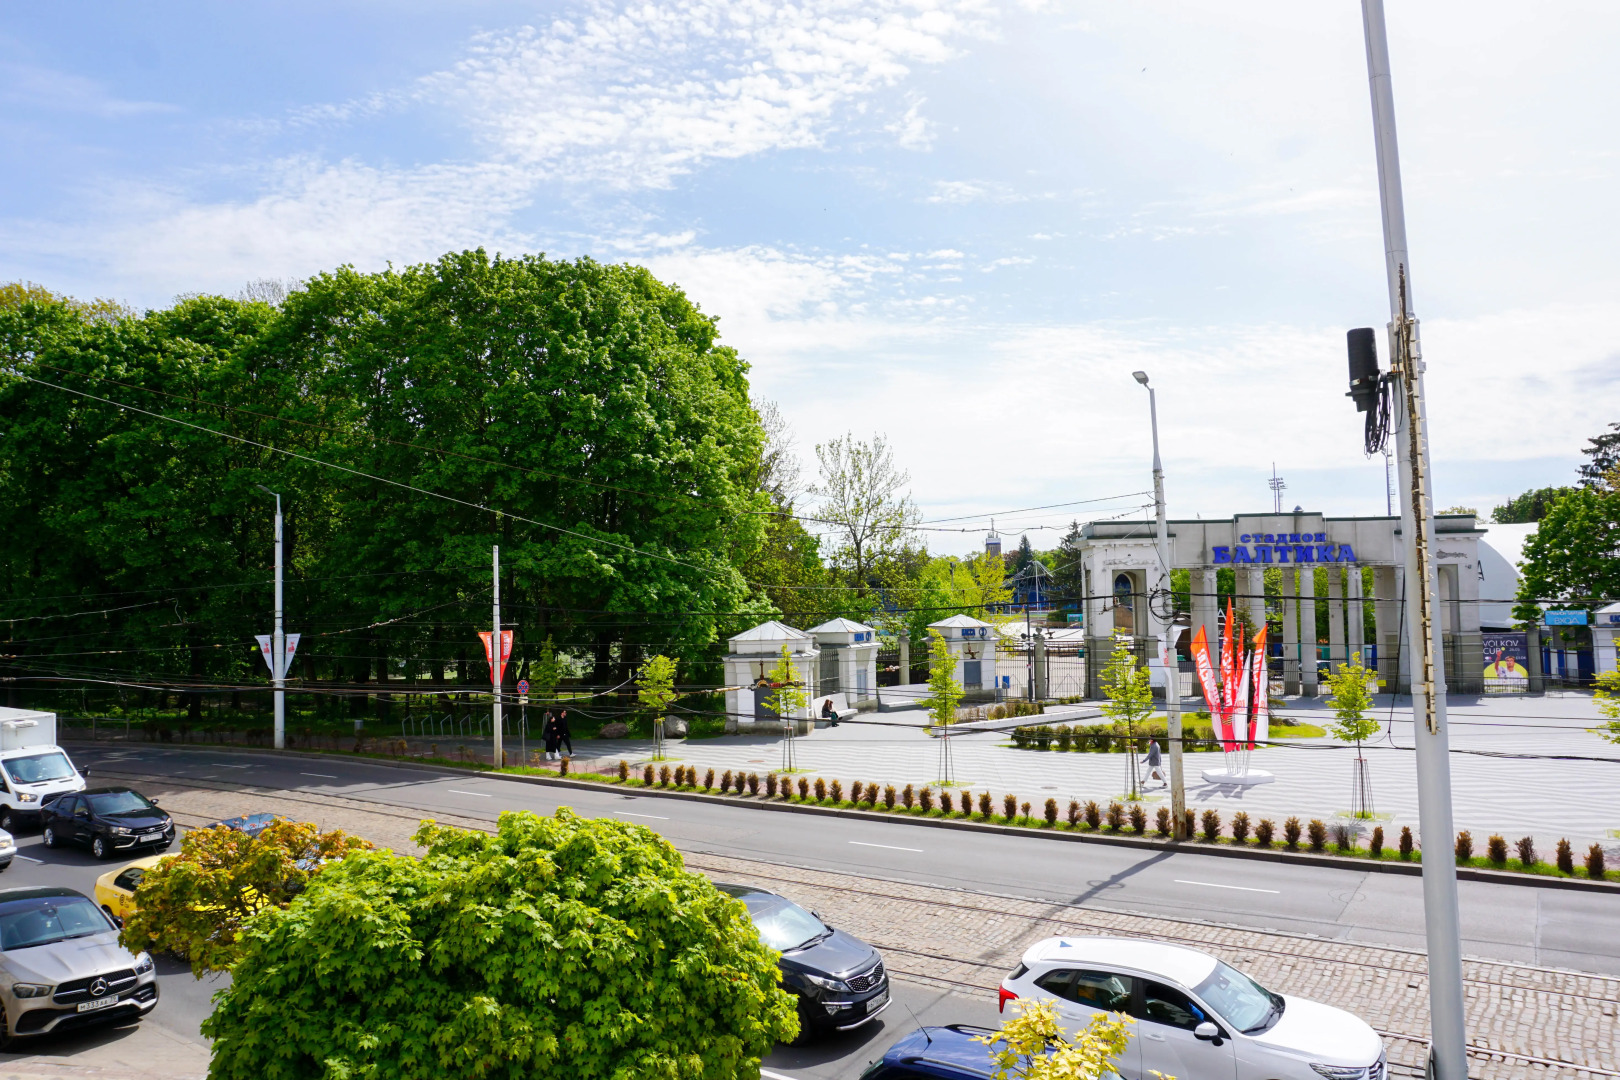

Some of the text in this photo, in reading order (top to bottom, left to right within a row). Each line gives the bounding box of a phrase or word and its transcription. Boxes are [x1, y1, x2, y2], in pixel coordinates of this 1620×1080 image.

[1212, 544, 1357, 564] БАЛТИКА
[1483, 639, 1519, 648] VOLKOV
[1483, 647, 1501, 655] CUP
